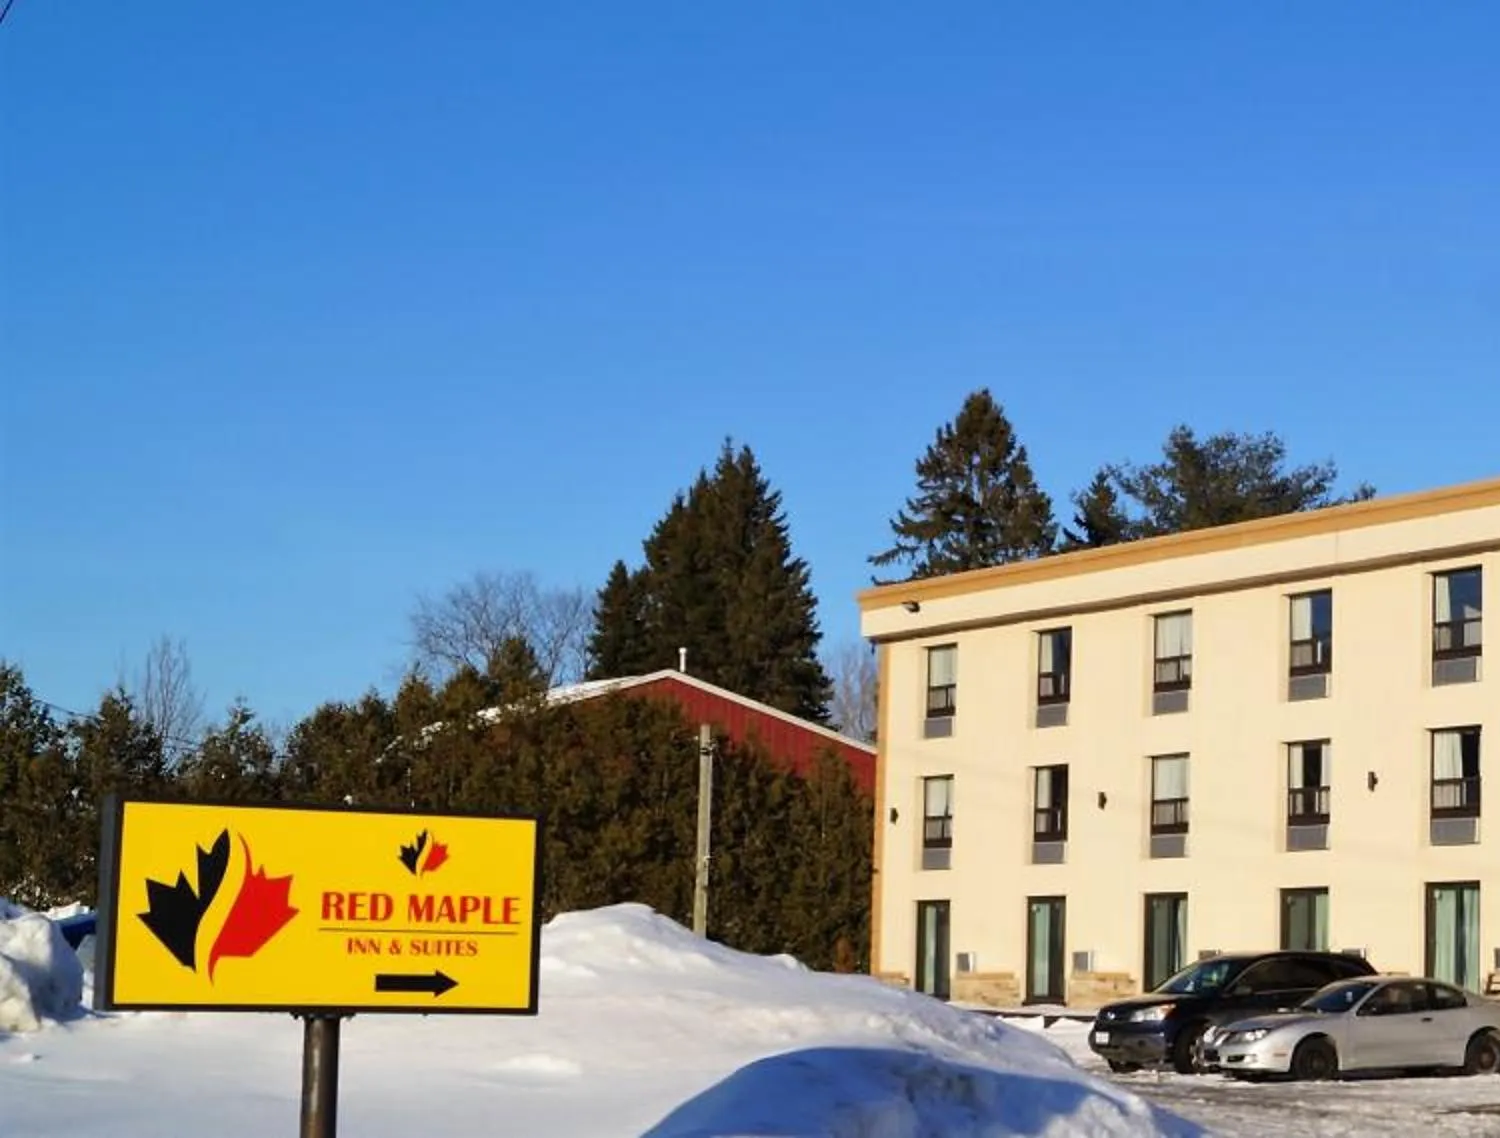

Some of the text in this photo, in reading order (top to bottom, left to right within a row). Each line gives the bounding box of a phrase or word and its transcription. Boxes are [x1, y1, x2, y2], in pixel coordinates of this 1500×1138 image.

[321, 891, 521, 925] RED MAPLE
[346, 937, 479, 957] INN & SUITES
